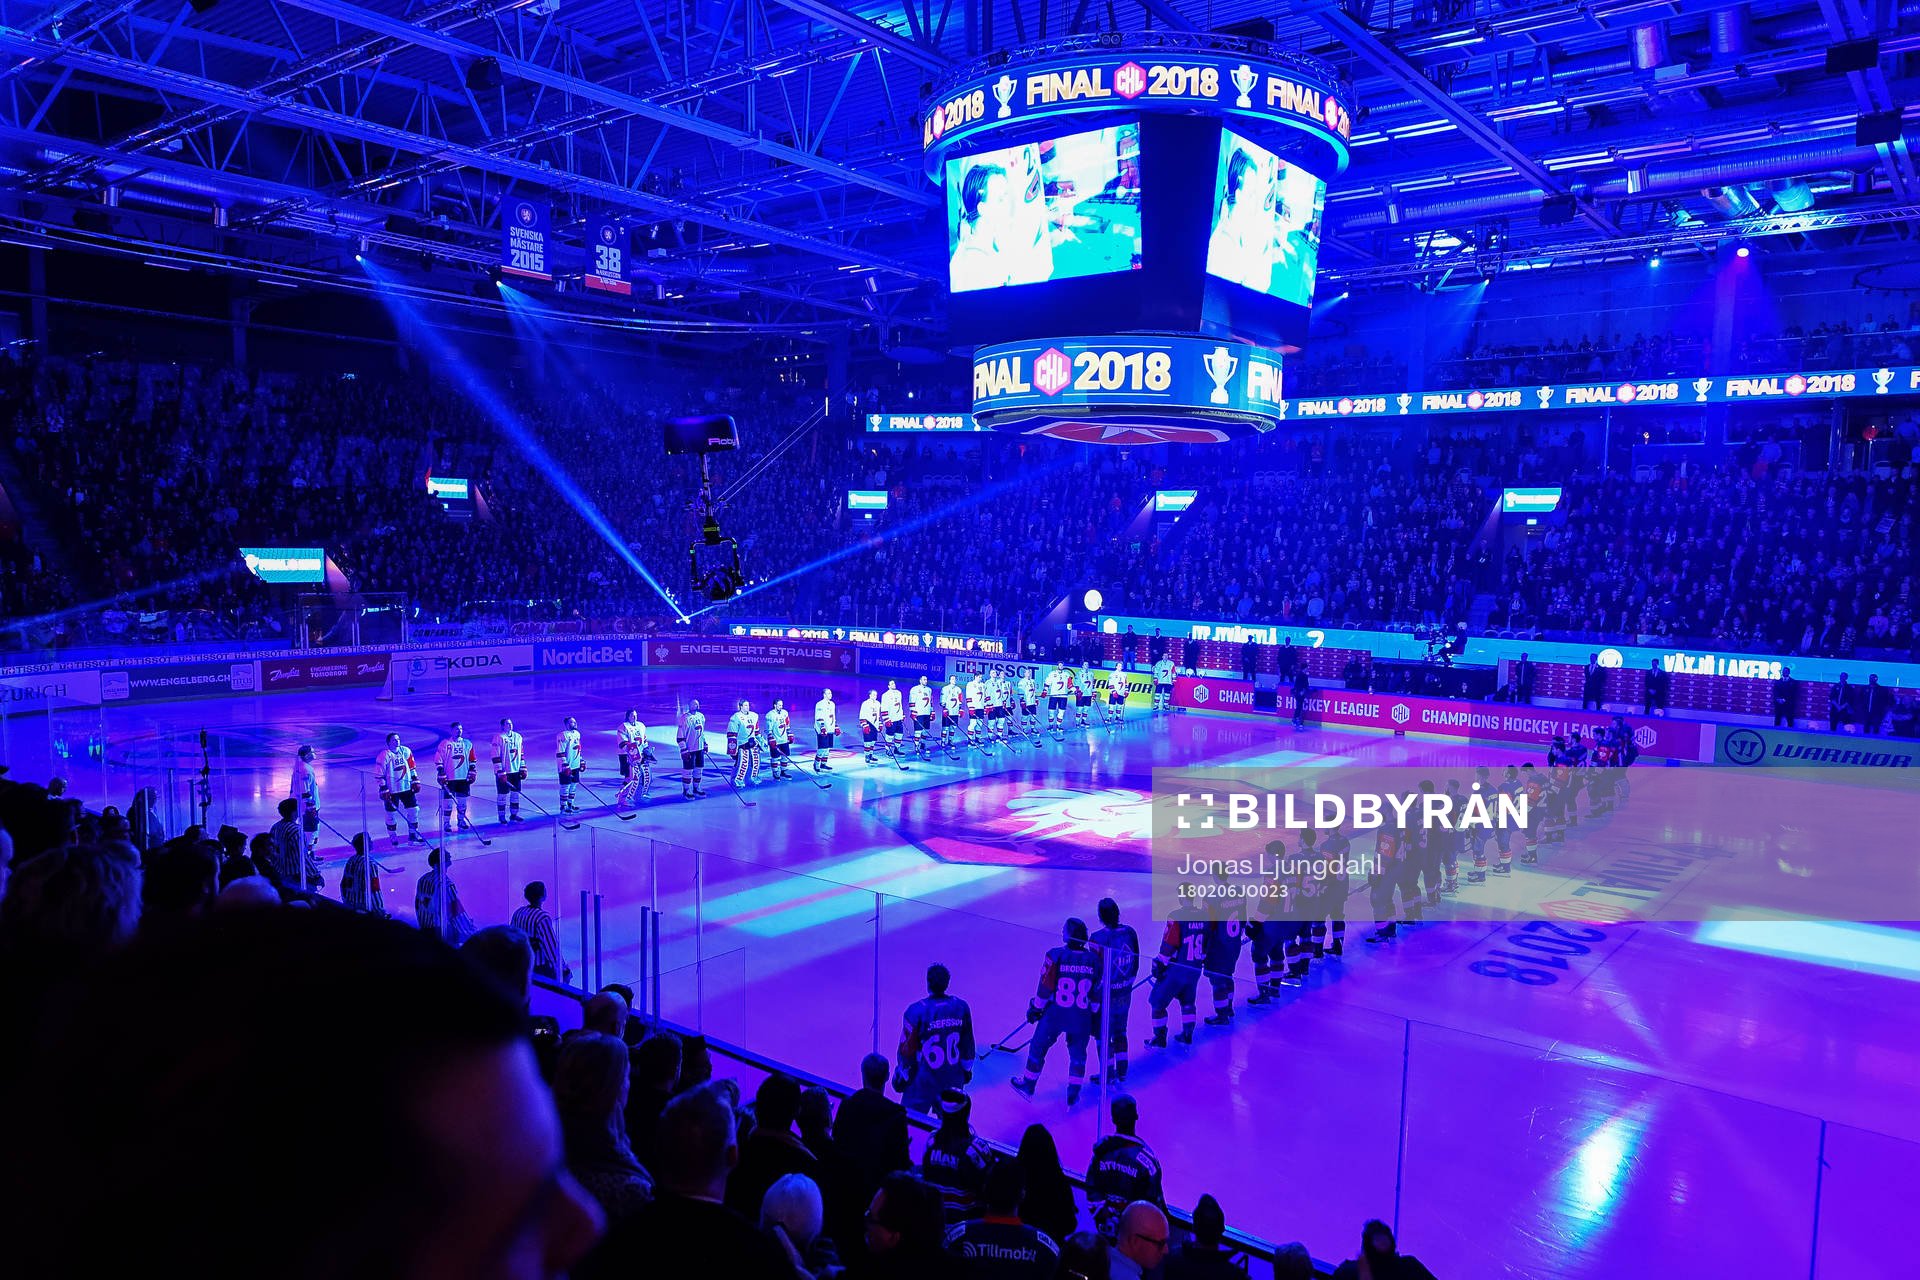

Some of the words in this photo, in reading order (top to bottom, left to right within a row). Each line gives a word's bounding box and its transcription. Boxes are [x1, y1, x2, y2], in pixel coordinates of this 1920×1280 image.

[1026, 68, 1111, 106] FINAL
[1148, 65, 1219, 97] 2018
[944, 90, 984, 131] 2018
[1267, 76, 1325, 122] FINAL
[510, 226, 544, 242] SVENSKA
[510, 237, 544, 253] MÄSTARE
[510, 248, 544, 272] 2015
[595, 244, 621, 273] 38
[1036, 352, 1069, 391] CHL
[1073, 351, 1171, 391] 2018
[1565, 385, 1616, 404] FINAL
[1636, 383, 1679, 400] 2018
[1726, 378, 1784, 397] FINAL
[1807, 374, 1856, 393] 2018
[1298, 401, 1338, 416] FINAL
[1352, 398, 1386, 414] 2018
[1422, 394, 1467, 411] FINAL
[1484, 391, 1521, 407] 2018
[890, 417, 923, 429] FINAL
[935, 416, 963, 429] 2018
[542, 646, 633, 666] NordicBet
[680, 644, 765, 655] ENGELBERT
[769, 646, 832, 659] STRAUSS
[733, 656, 785, 664] WORKWEAR
[876, 658, 899, 668] PRIVATE
[900, 661, 928, 671] BANKING
[130, 674, 231, 688] WWW.ENGELBERG.CH
[1333, 700, 1380, 718] LEAGUE
[1393, 704, 1409, 723] CHL
[1422, 709, 1500, 730] CHAMPIONS
[1503, 717, 1559, 736] HOCKEY
[1772, 743, 1913, 768] WARRIOR
[1226, 910, 1240, 938] 6
[1468, 919, 1607, 986] 2018
[1056, 976, 1092, 1010] 88
[920, 1031, 960, 1070] 60
